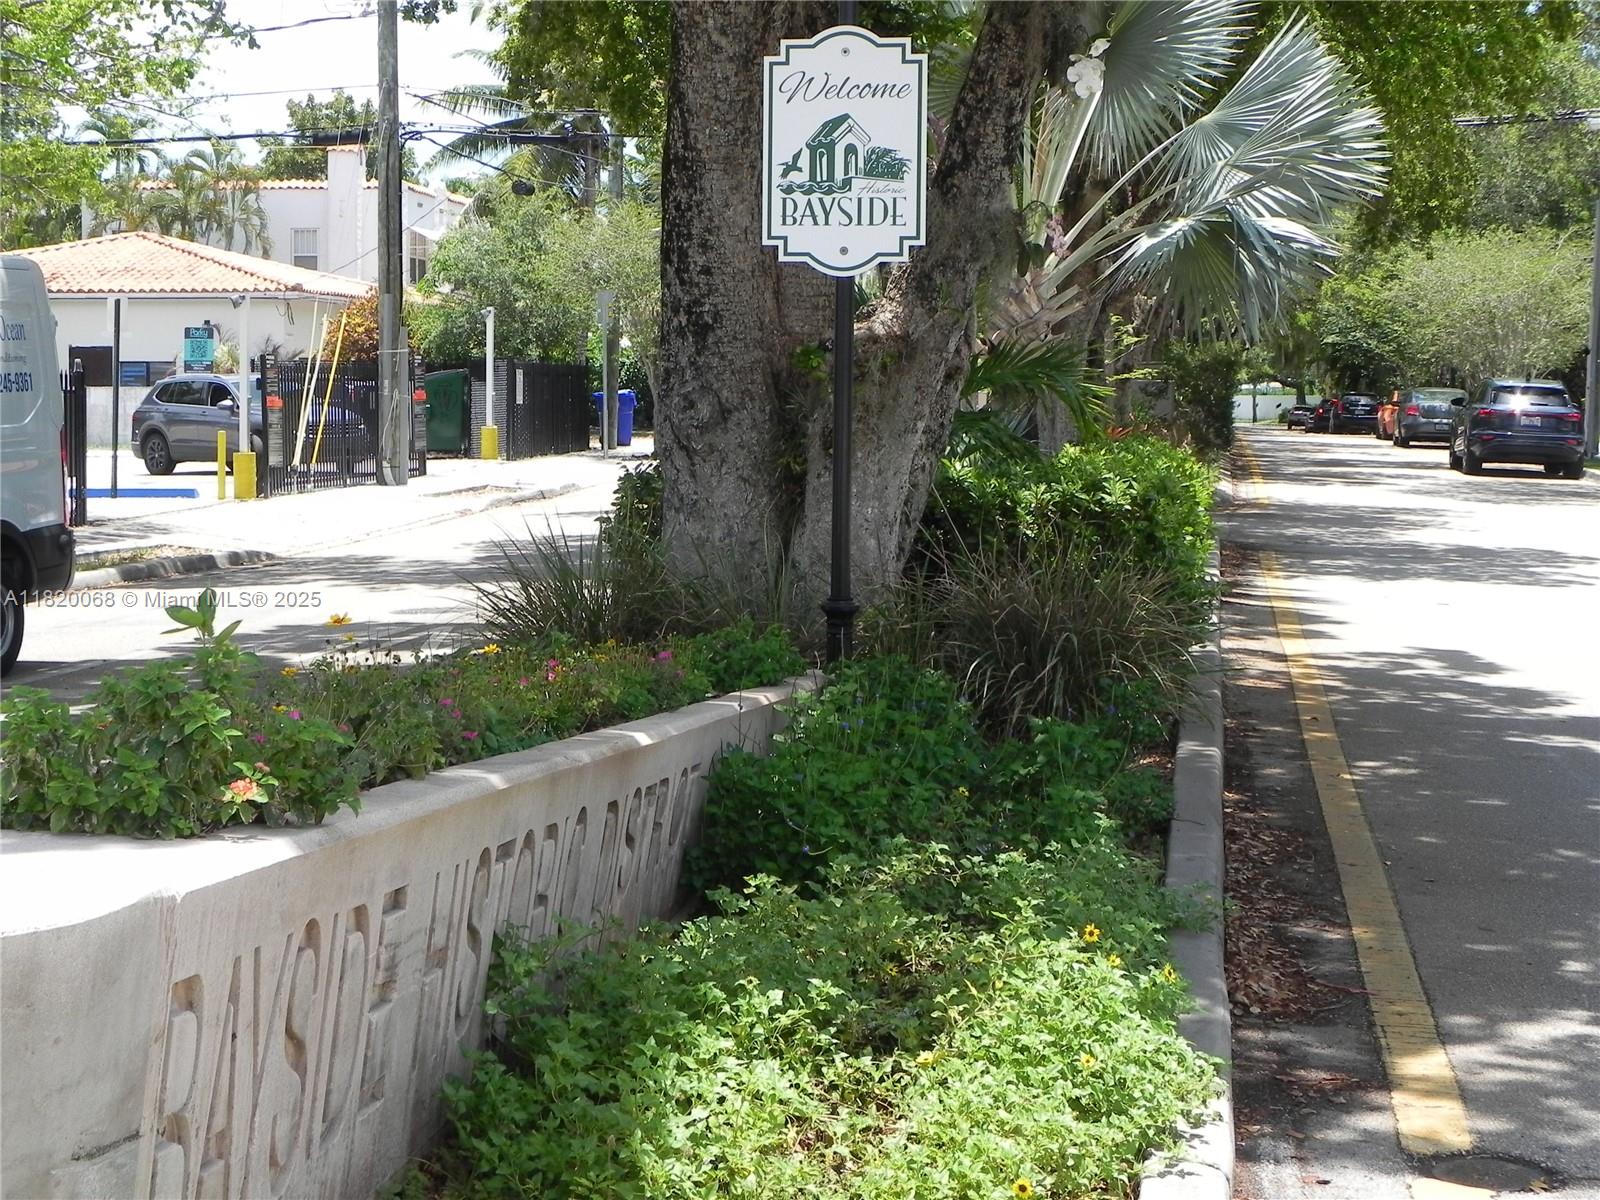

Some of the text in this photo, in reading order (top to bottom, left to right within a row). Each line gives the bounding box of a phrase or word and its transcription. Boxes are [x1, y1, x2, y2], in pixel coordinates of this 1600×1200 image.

[778, 70, 912, 104] Welcome
[857, 180, 906, 196] Historic
[780, 197, 907, 227] BAYSIDE
[148, 884, 410, 1200] BAYSIDE
